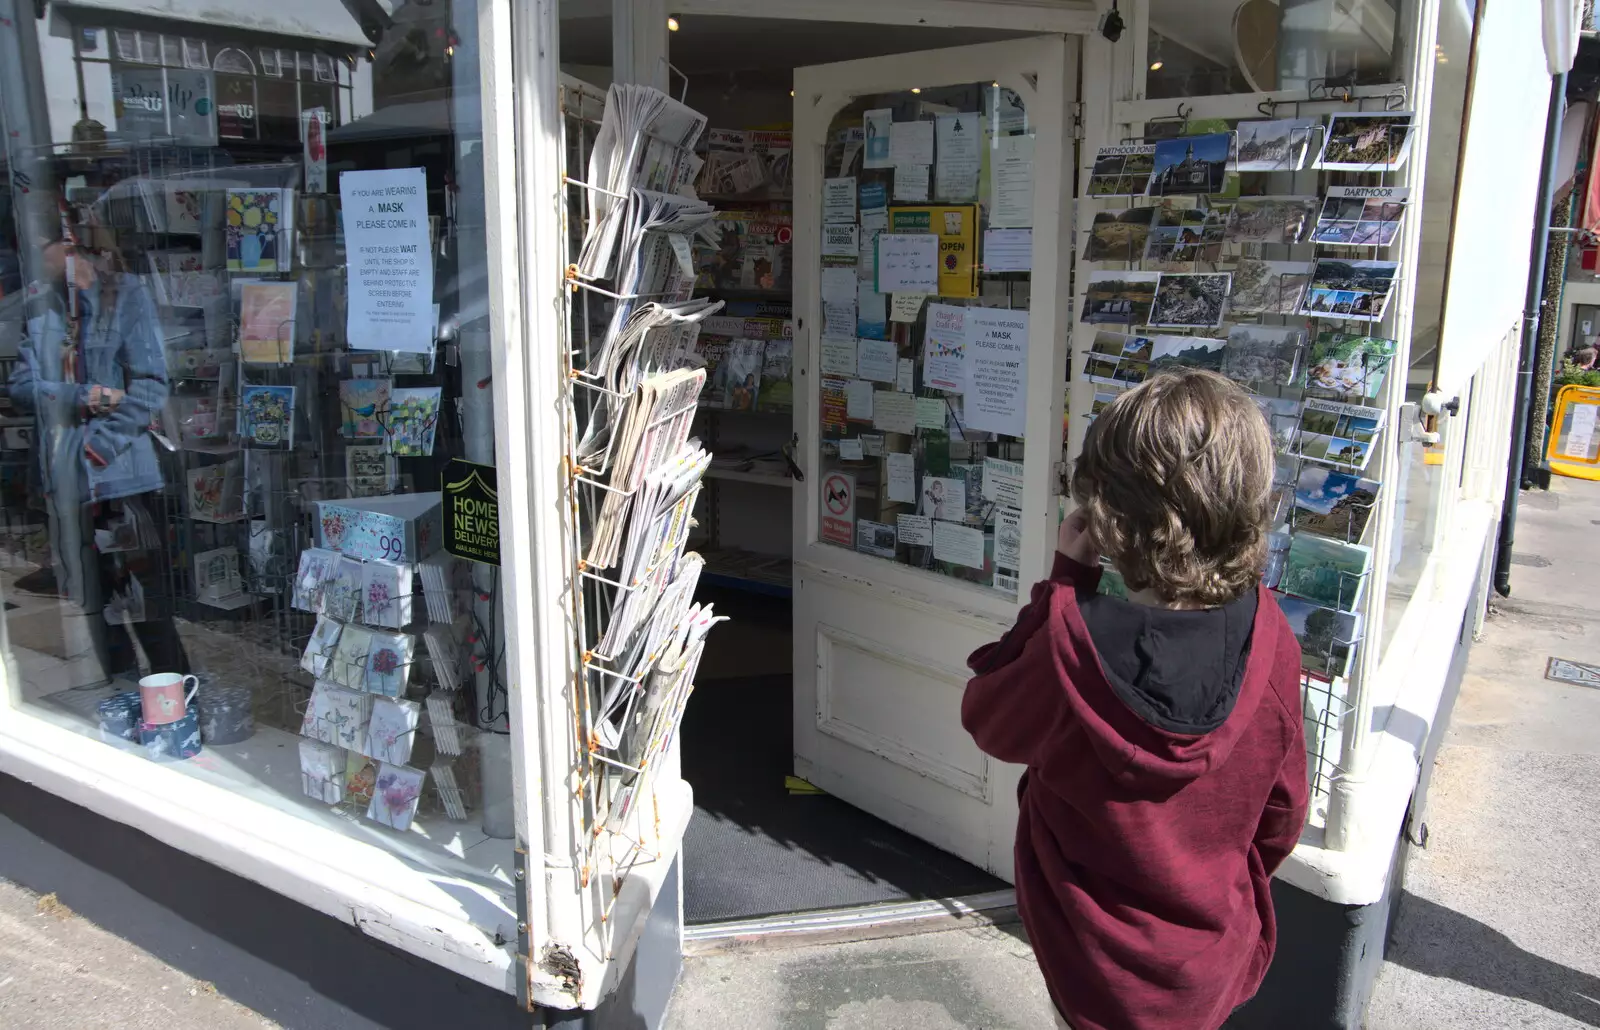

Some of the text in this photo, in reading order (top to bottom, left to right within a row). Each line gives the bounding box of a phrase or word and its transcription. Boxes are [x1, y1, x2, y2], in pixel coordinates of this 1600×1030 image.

[1098, 146, 1135, 154] DARTMOOR
[384, 186, 416, 196] WEARING
[1344, 188, 1392, 197] DARTMOOR
[368, 202, 404, 213] A MASK
[356, 220, 416, 229] PLEASE COME IN
[778, 226, 792, 244] Q
[827, 236, 852, 245] LASHBROOK
[400, 244, 417, 253] WAIT
[940, 242, 965, 252] OPEN
[377, 300, 404, 308] ENTERING
[998, 321, 1024, 330] WEARING
[992, 331, 1012, 340] MASK
[976, 340, 996, 350] PLEASE
[998, 342, 1014, 351] COME
[992, 383, 1018, 392] PROTECTIVE
[1309, 400, 1376, 418] Dartmoor Megaliths
[454, 496, 498, 520] HOME
[454, 513, 498, 537] NEWS
[455, 530, 498, 548] DELIVERY
[380, 536, 402, 562] 99
[455, 544, 498, 560] AVAILABLE HERE
